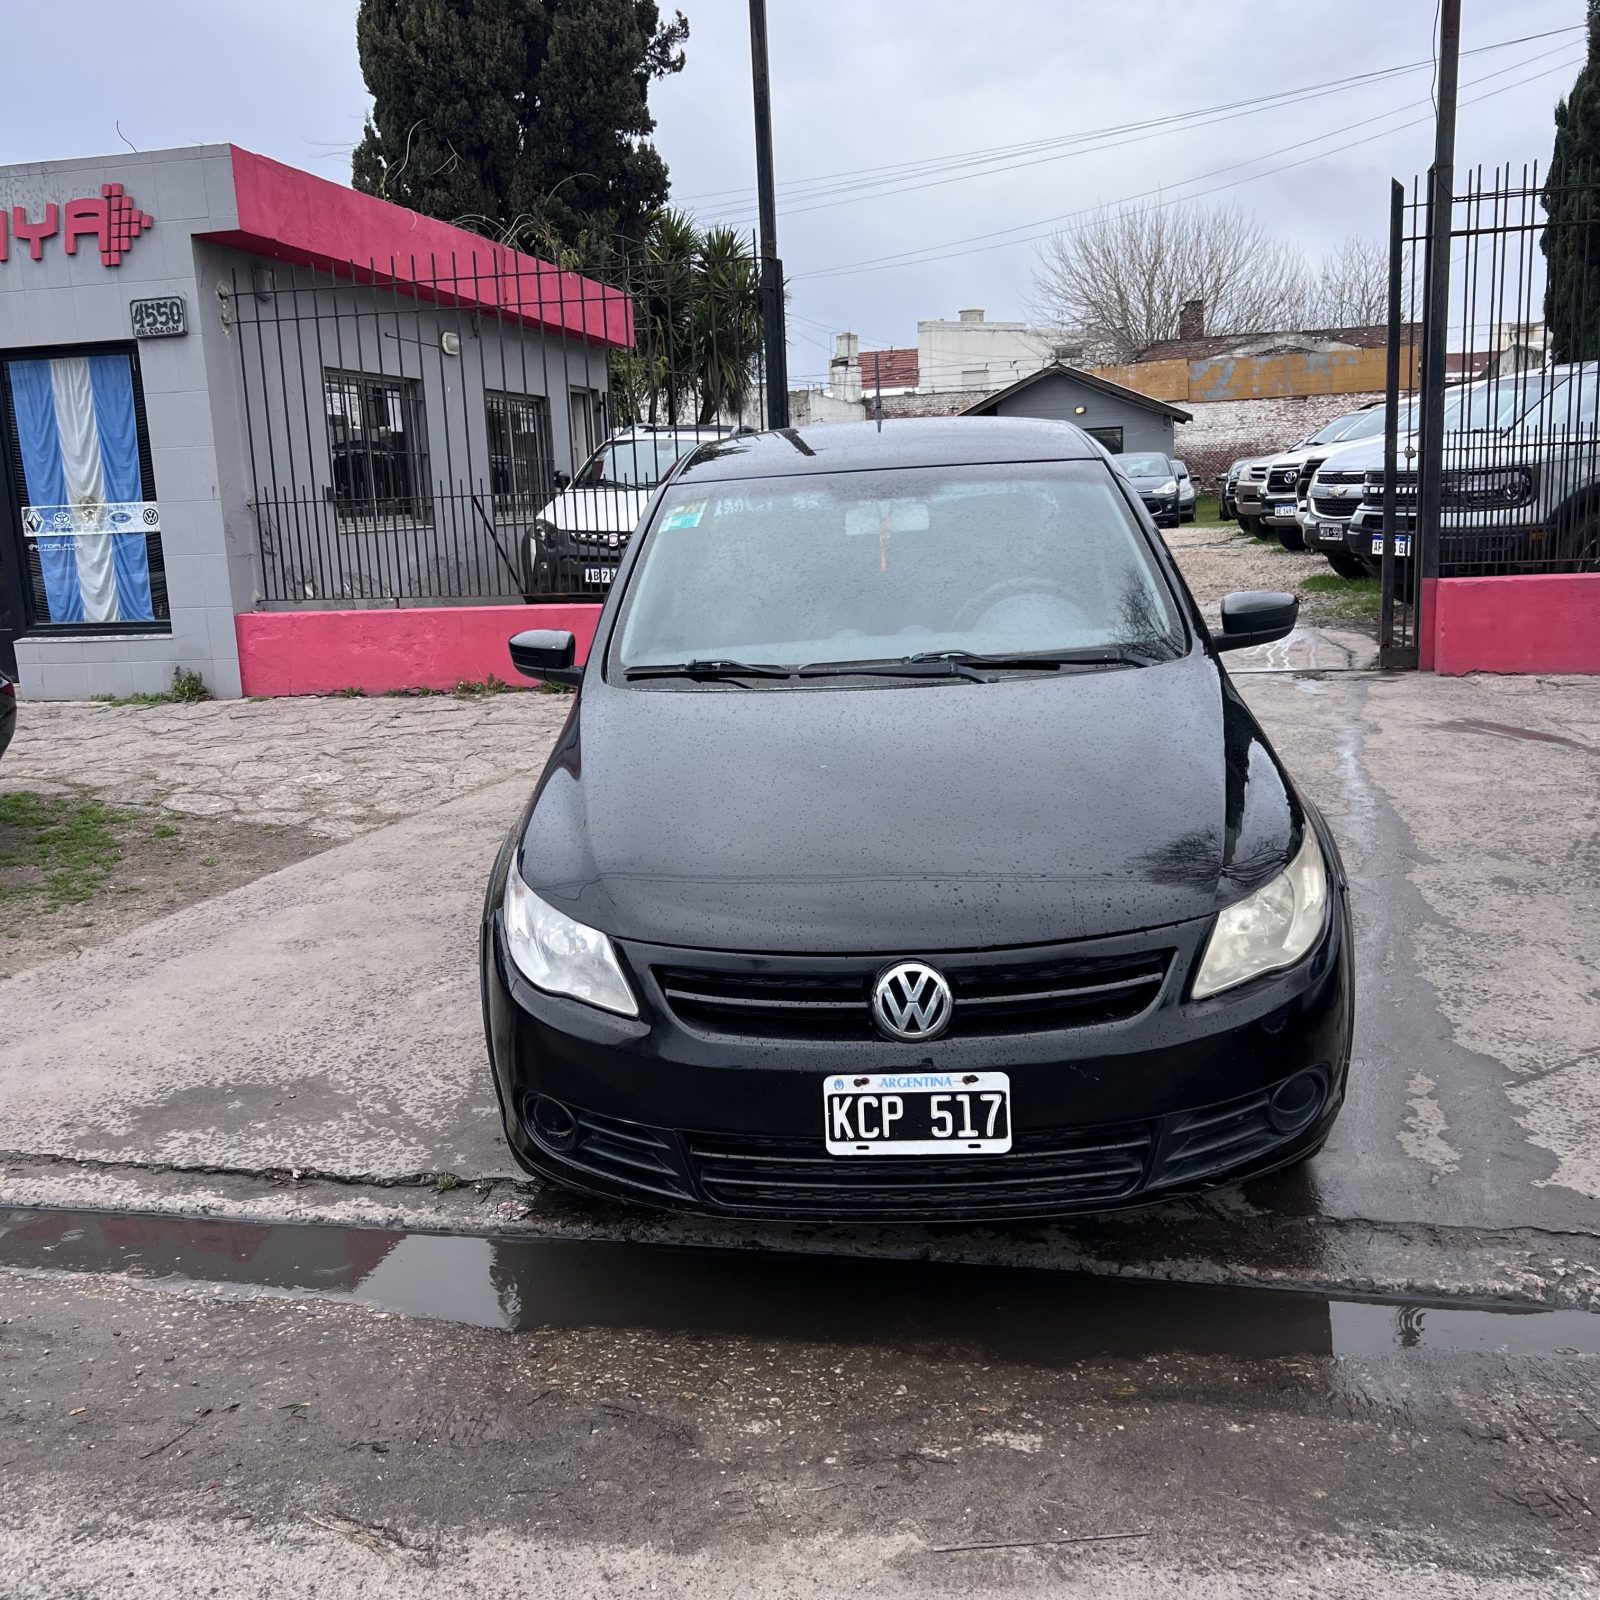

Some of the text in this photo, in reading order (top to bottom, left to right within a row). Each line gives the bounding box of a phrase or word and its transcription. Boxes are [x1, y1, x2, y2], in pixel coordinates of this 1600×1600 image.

[0, 197, 111, 262] YA
[133, 301, 182, 328] 4550
[879, 1076, 953, 1089] ARGENTINA
[832, 1094, 1002, 1139] KCP 517
